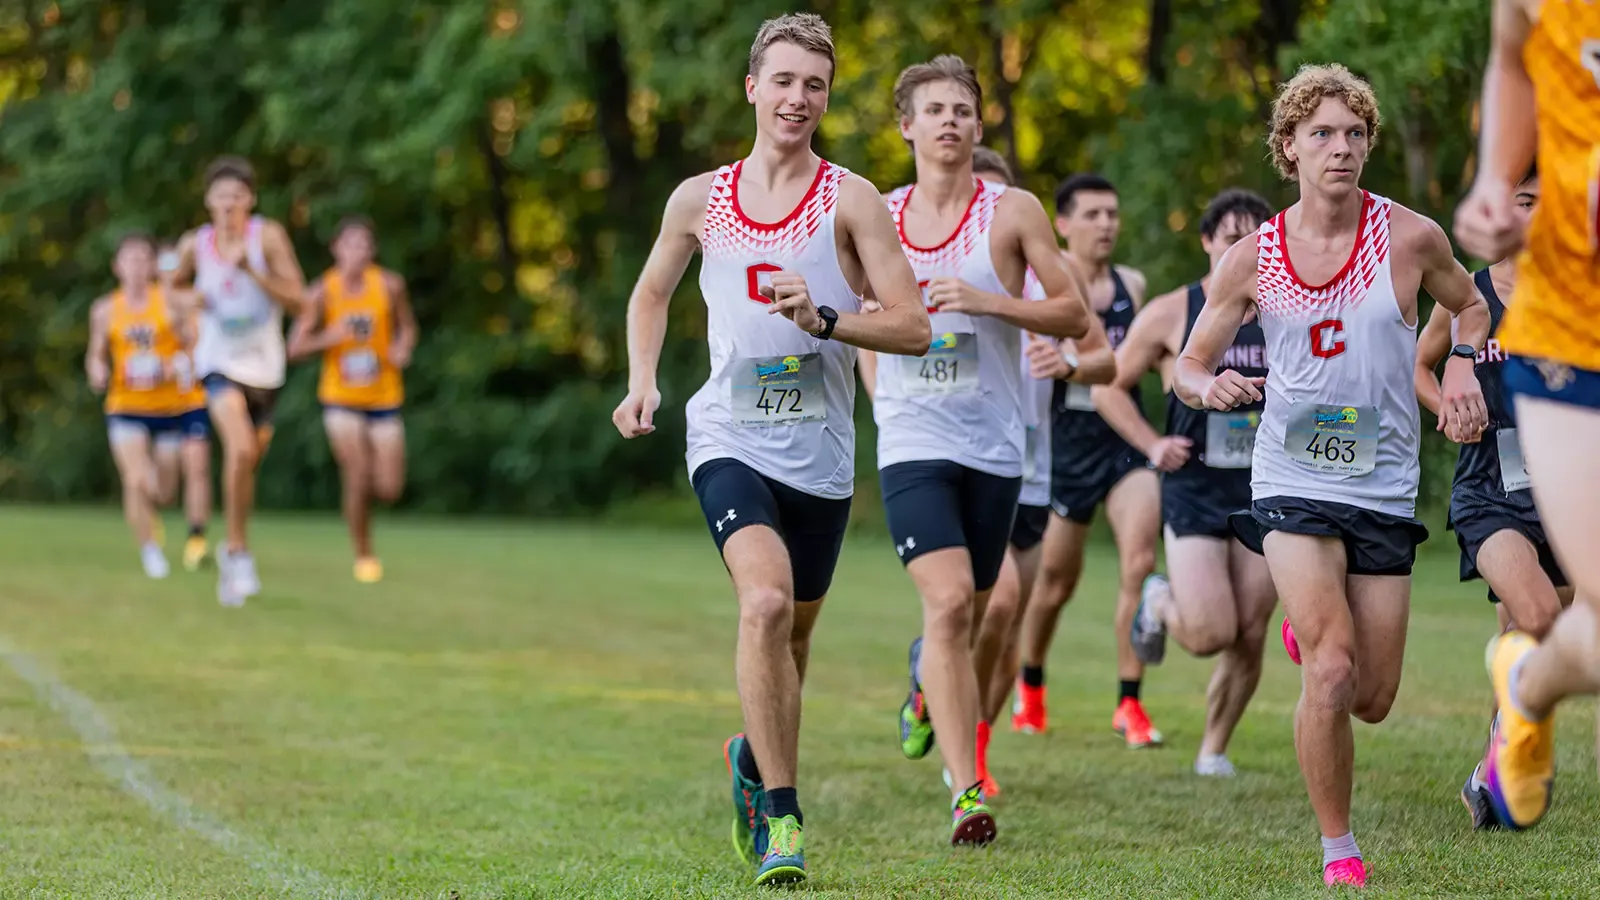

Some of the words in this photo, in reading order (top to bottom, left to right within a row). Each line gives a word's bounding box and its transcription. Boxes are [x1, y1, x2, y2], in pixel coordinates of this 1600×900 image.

[1308, 318, 1347, 360] C
[919, 359, 958, 384] 481
[756, 387, 803, 415] 472
[1305, 432, 1357, 464] 463
